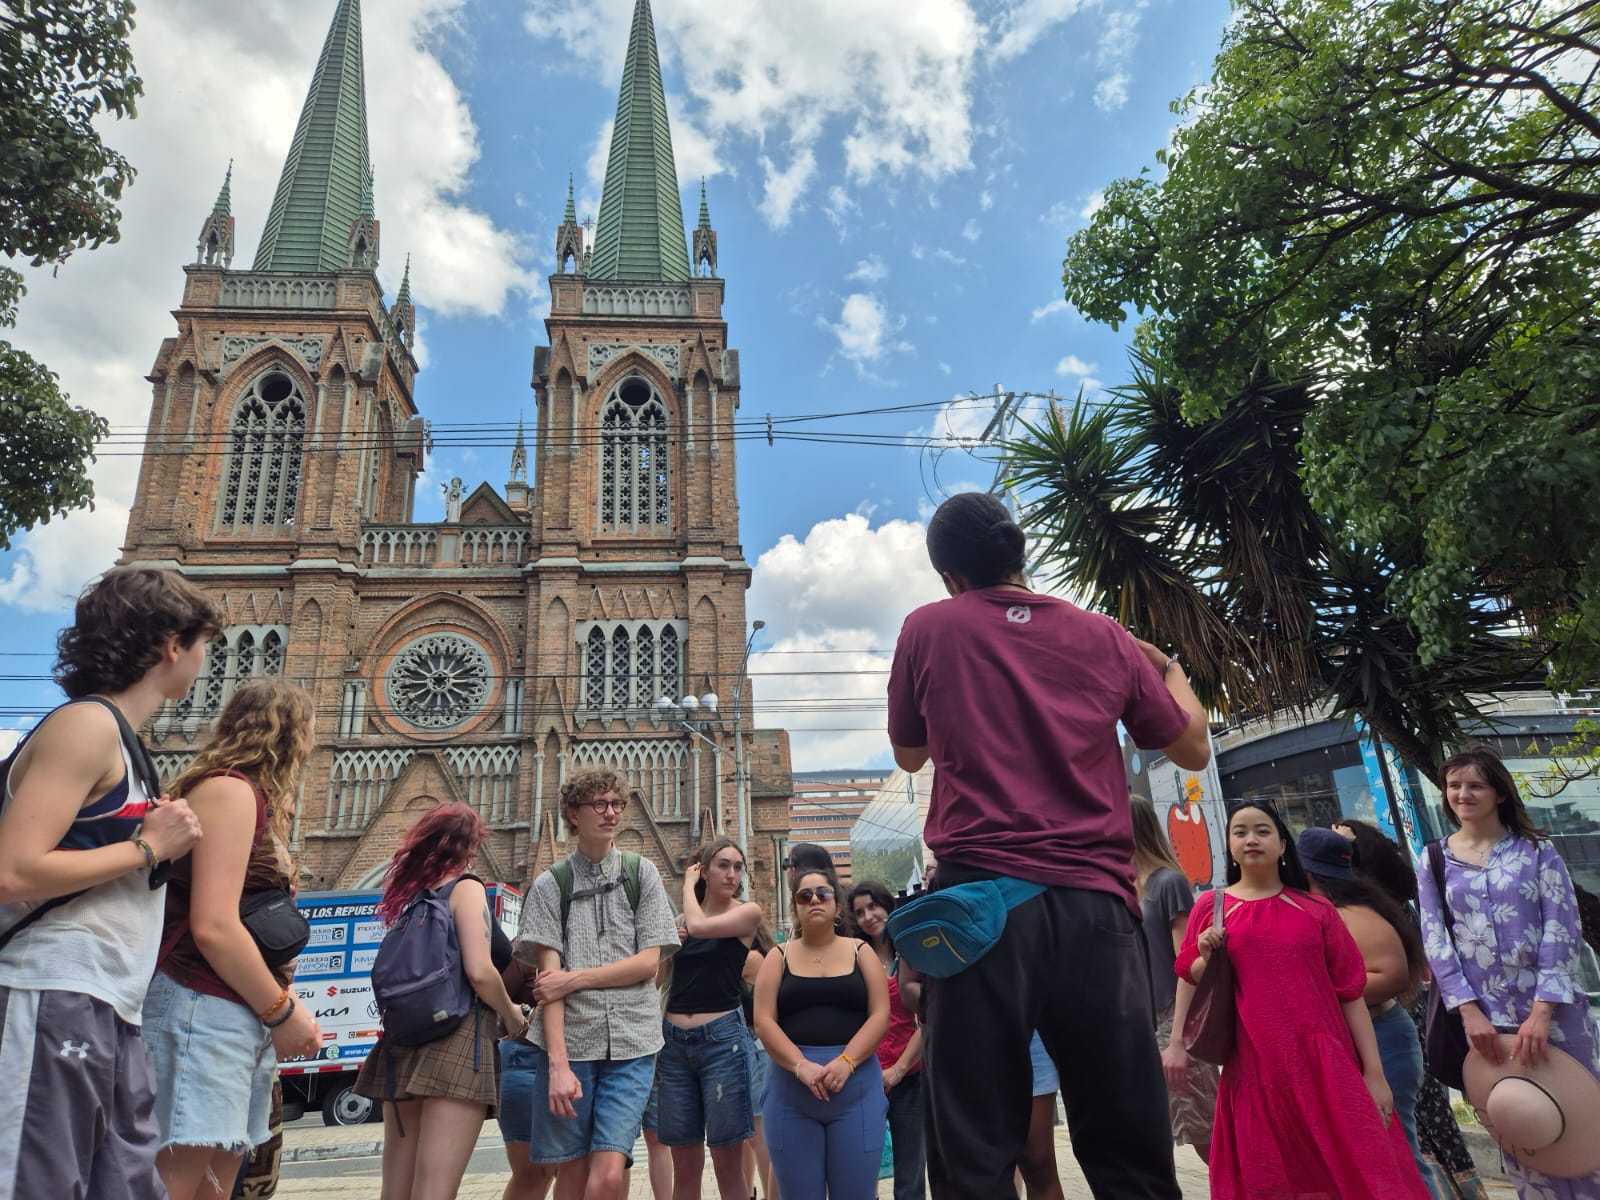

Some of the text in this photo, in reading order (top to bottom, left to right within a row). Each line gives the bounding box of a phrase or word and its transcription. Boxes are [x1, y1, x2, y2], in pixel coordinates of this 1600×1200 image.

[312, 907, 332, 919] LOS
[340, 986, 371, 994] SUZUKI
[315, 1006, 350, 1018] KIA
